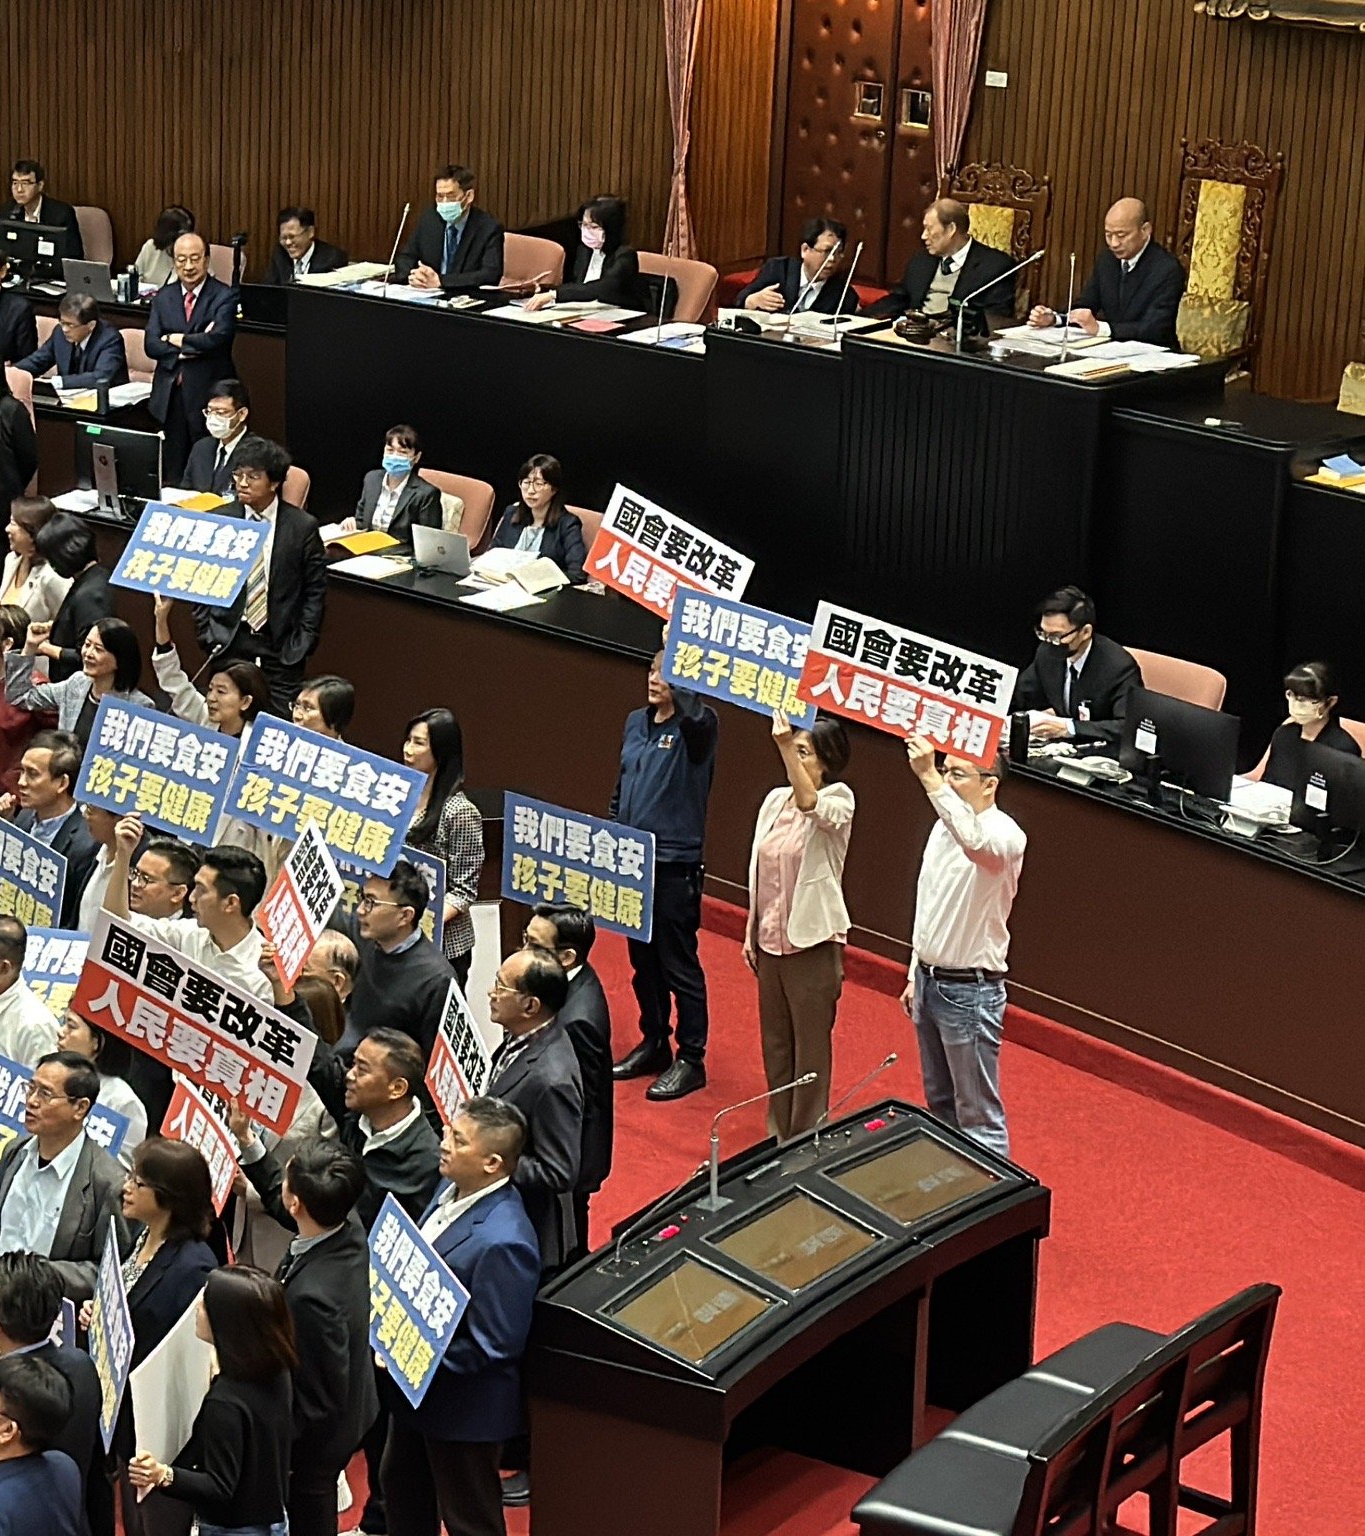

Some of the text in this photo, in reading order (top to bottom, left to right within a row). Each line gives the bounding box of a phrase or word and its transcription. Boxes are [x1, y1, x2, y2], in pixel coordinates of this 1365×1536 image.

[121, 548, 244, 600] 孩子要健康
[141, 508, 261, 562] 我們要食安
[595, 542, 677, 613] 人民要
[612, 496, 742, 593] 國會要改革
[823, 613, 1005, 706] 國會要改革
[98, 707, 230, 785] 我們要食安
[811, 663, 995, 758] 人民要真相
[85, 755, 215, 835] 孩子要健康
[255, 726, 413, 817] 我們要食安
[238, 772, 395, 864] 孩子要健康
[513, 805, 646, 880] 我們要食安
[511, 852, 644, 931] 孩子要健康
[101, 922, 302, 1069] 國會要改革
[88, 978, 288, 1124] 人民要真相
[373, 1211, 459, 1339] 我們要食安
